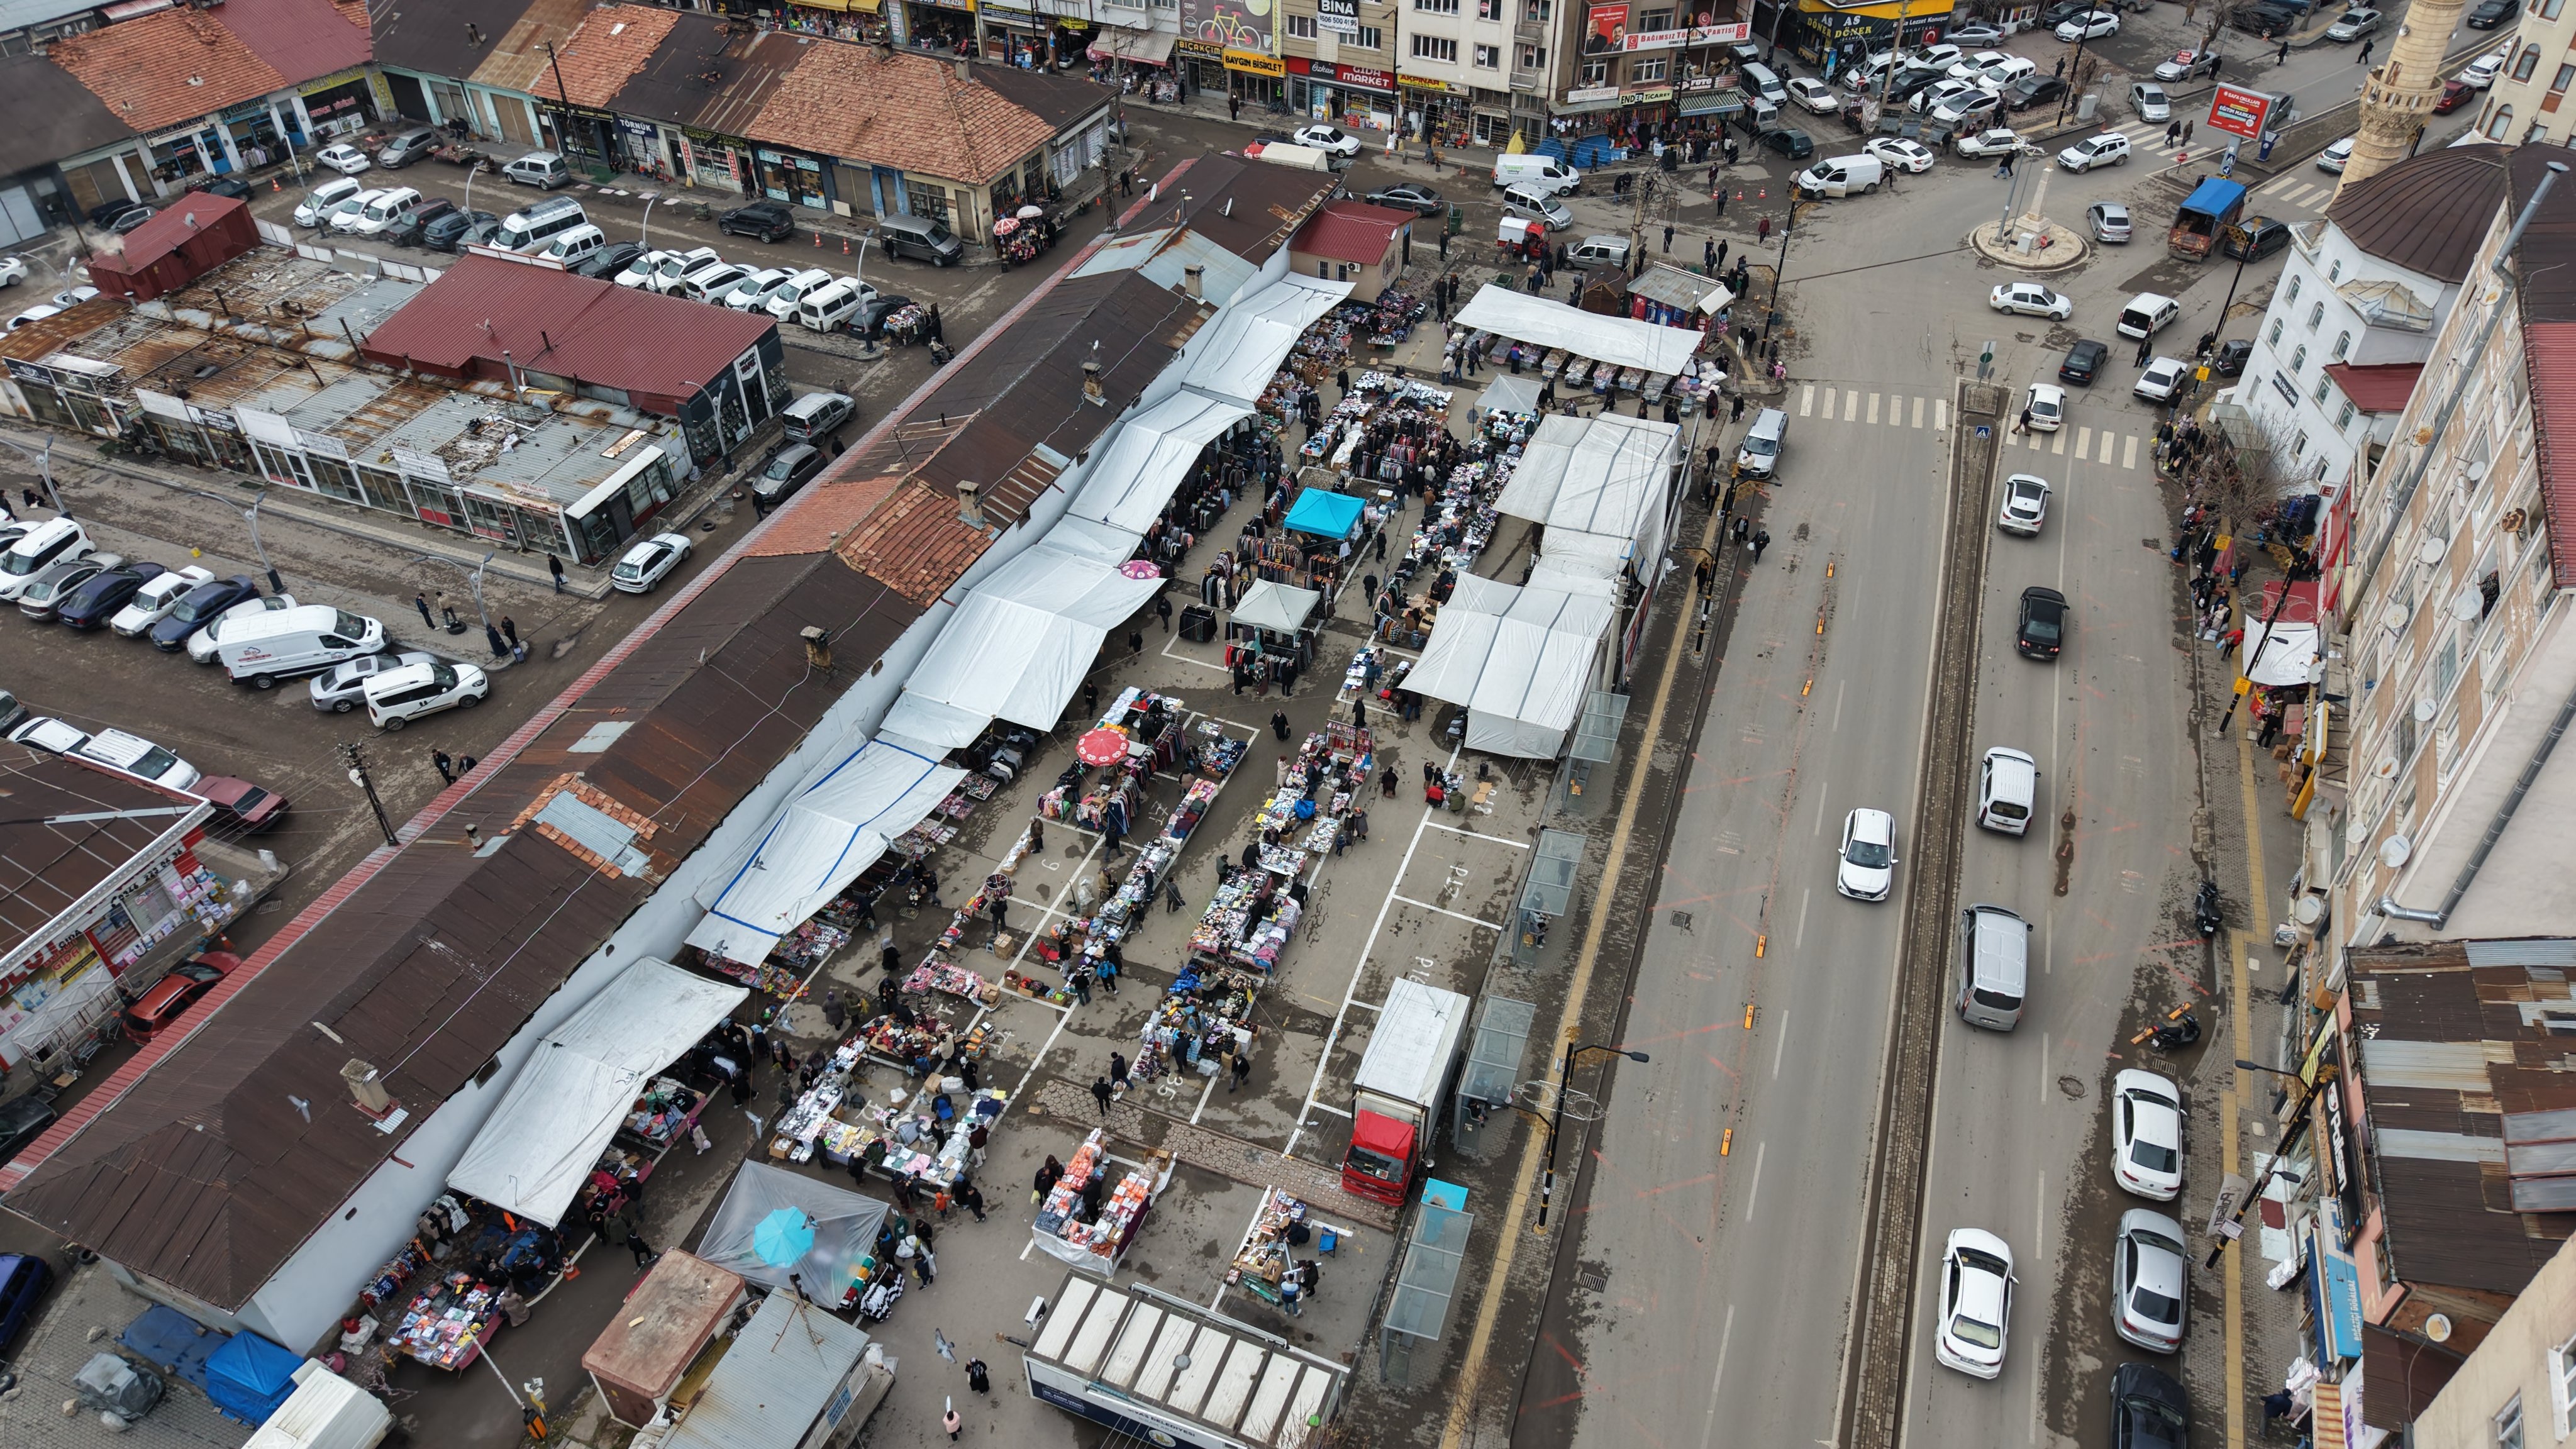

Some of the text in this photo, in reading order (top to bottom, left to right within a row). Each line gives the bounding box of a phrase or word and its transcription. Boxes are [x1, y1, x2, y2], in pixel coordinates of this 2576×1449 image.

[1321, 0, 1354, 15] BİNA
[1821, 14, 1833, 27] AS
[1843, 15, 1861, 26] AS
[1807, 17, 1831, 38] DÖNER
[1835, 26, 1872, 38] DÖNER
[1641, 33, 1675, 43] BAĞIMSIZ
[1707, 26, 1735, 36] PARTİSİ
[1225, 55, 1251, 67] BAYGIN
[1312, 62, 1335, 75] Özkan
[1343, 72, 1389, 87] MARKET
[1690, 77, 1713, 87] FOTO
[1621, 92, 1671, 105] ENDER TİCARET
[52, 947, 80, 972] GIDA
[2331, 1110, 2349, 1192] Polisan
